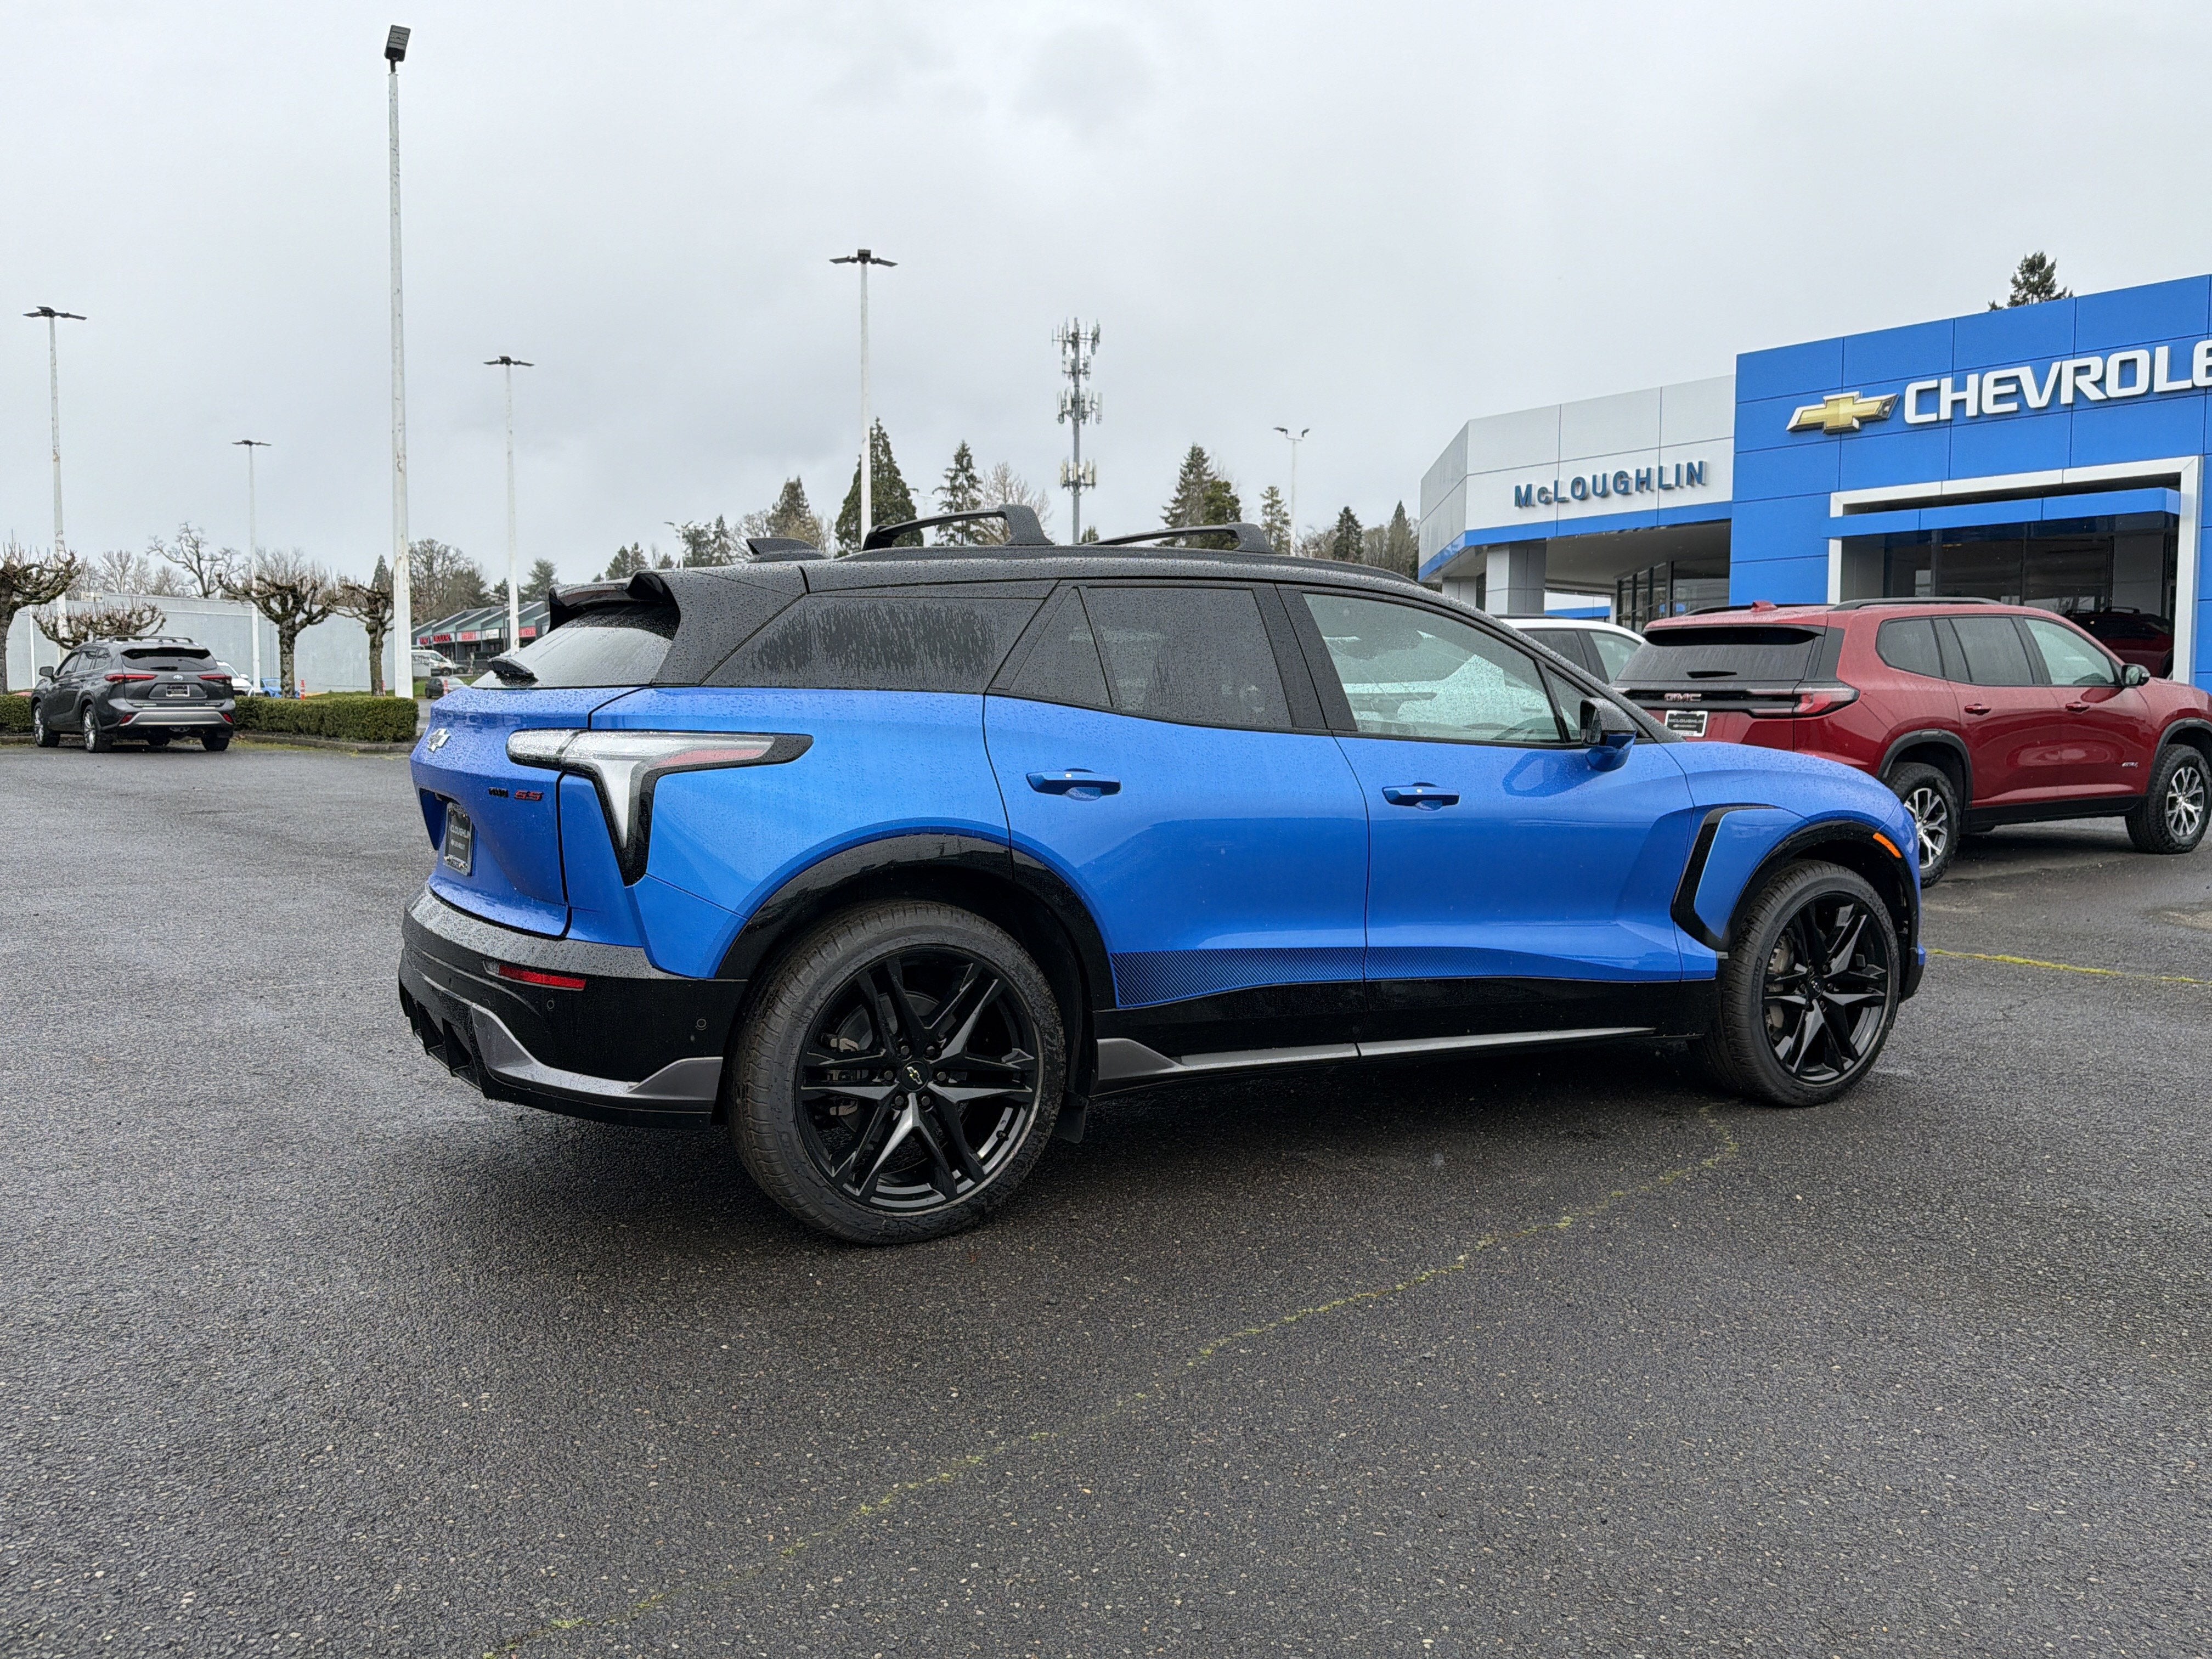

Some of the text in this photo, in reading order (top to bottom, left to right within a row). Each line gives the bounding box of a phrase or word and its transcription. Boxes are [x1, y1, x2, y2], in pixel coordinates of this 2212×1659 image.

[1514, 460, 1707, 508] McLOUGHLIN
[1664, 692, 1702, 702] GMC
[514, 789, 544, 802] SS
